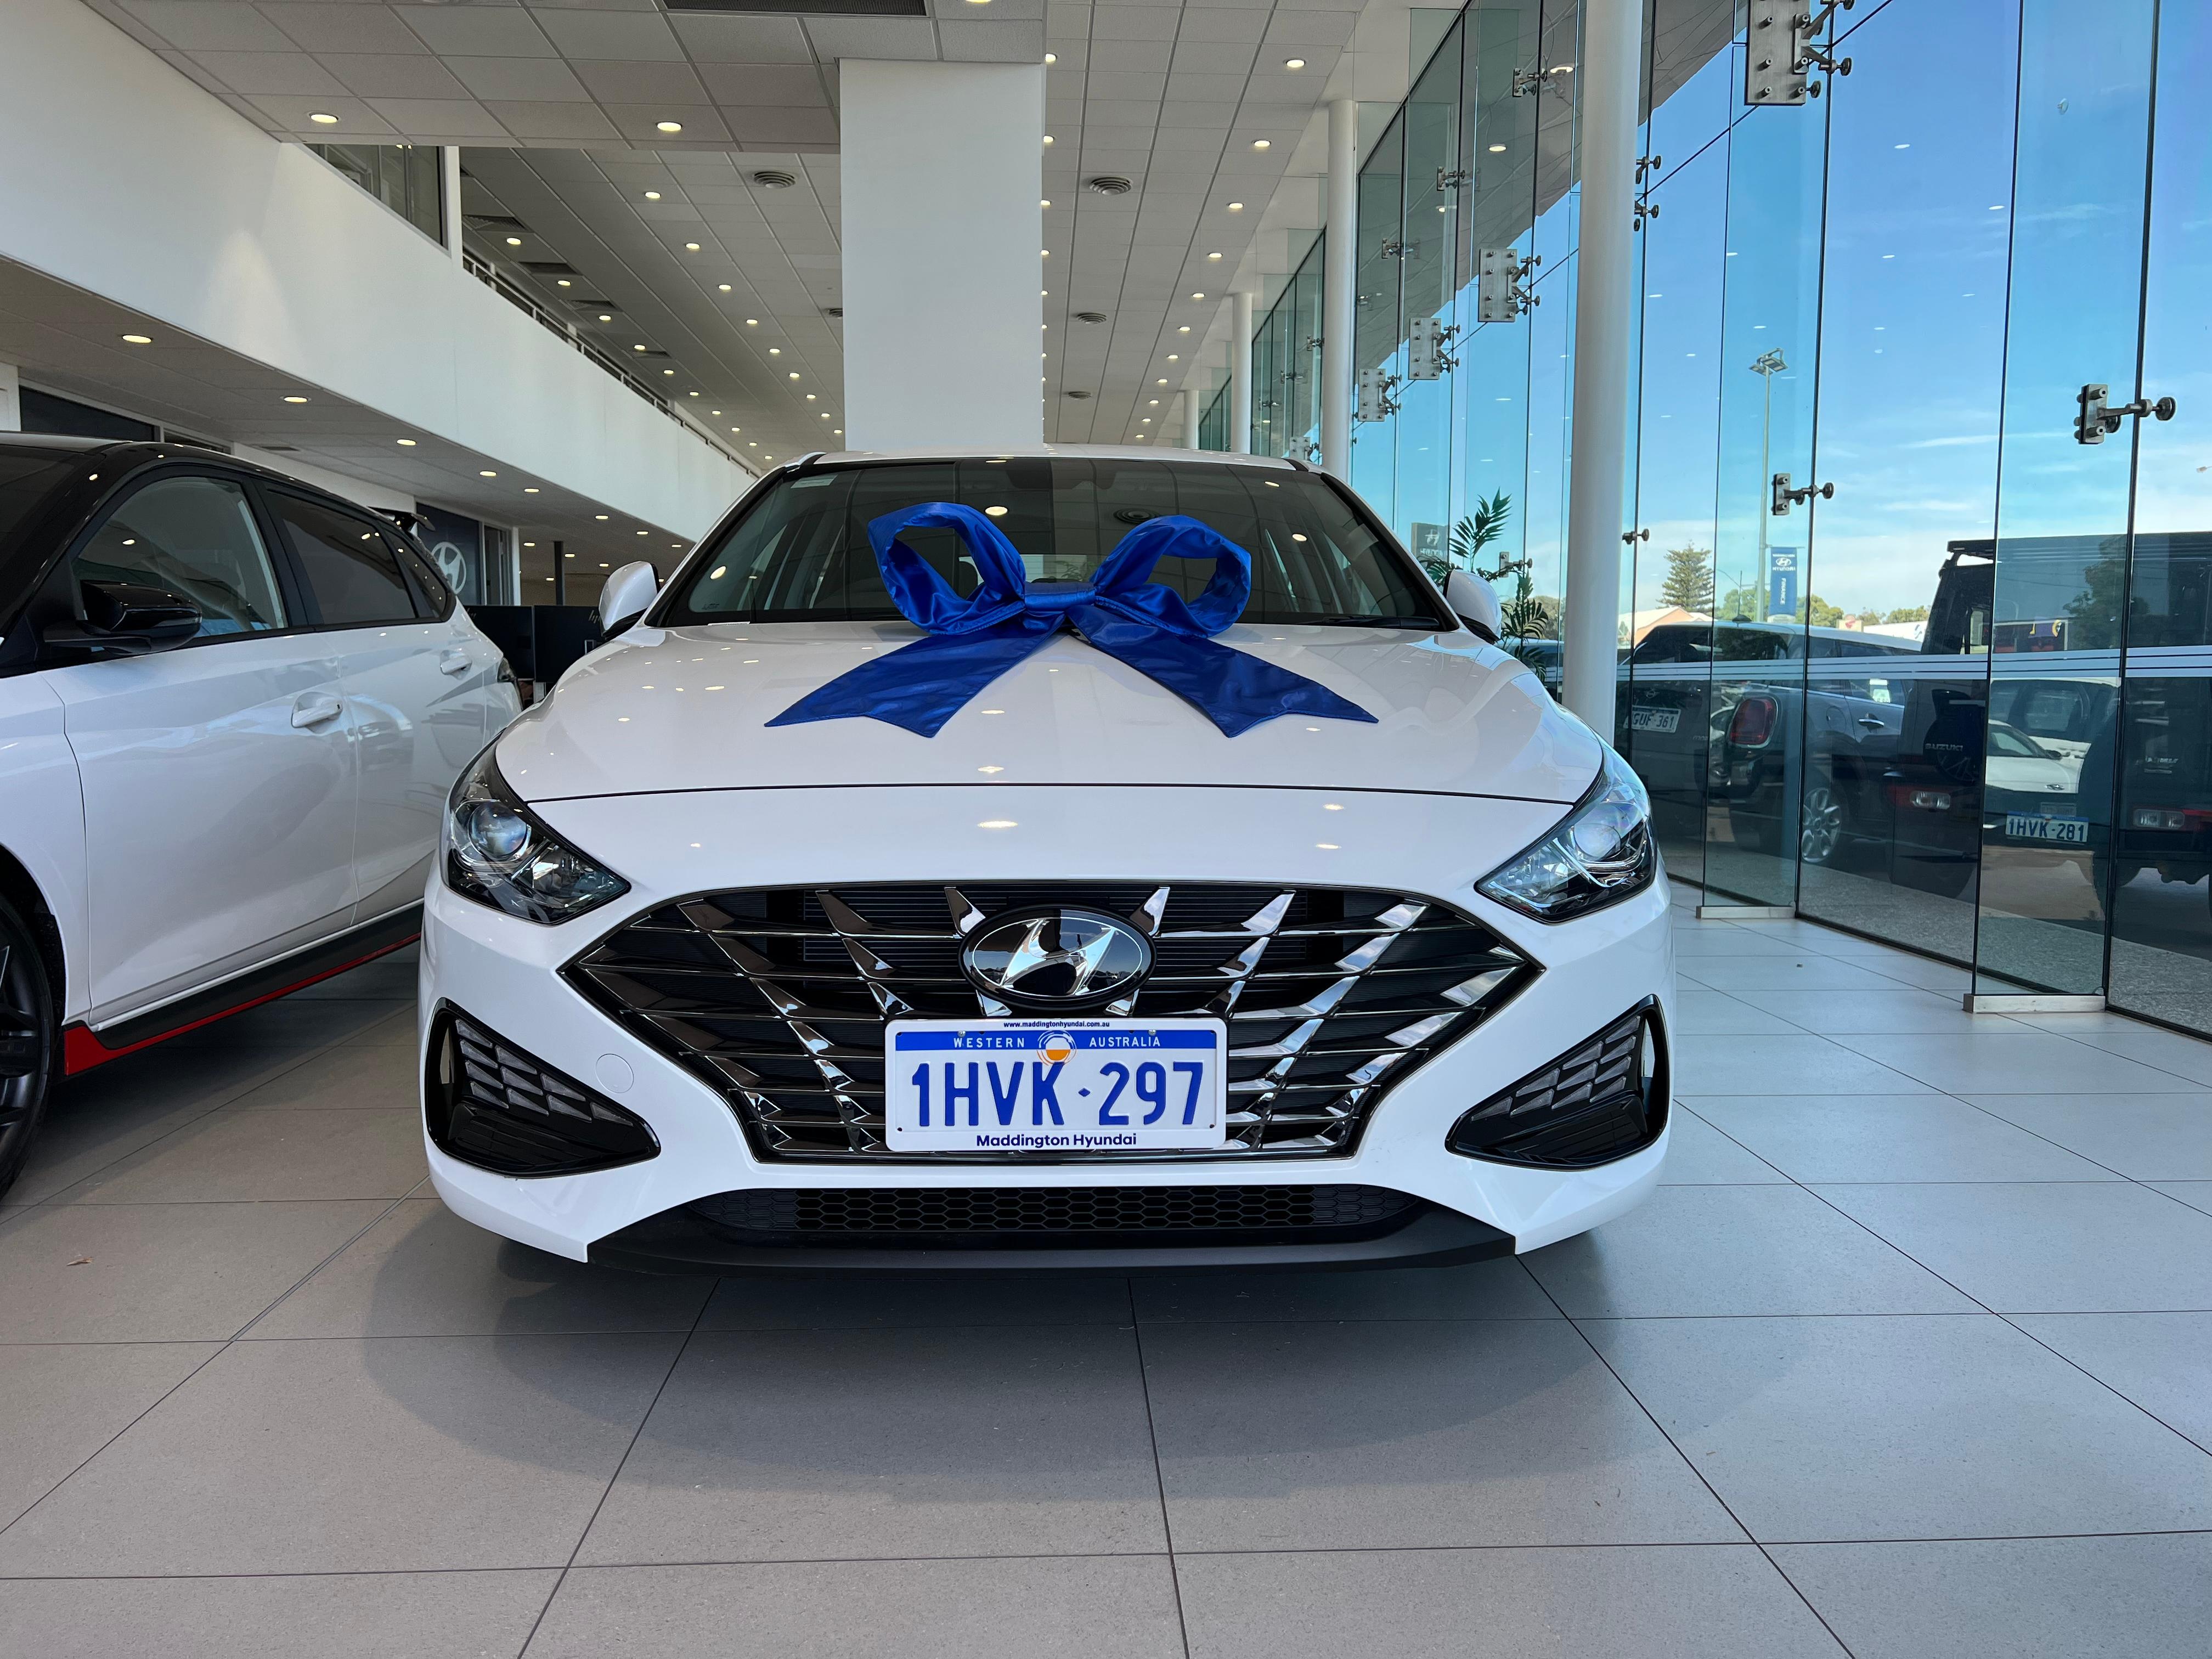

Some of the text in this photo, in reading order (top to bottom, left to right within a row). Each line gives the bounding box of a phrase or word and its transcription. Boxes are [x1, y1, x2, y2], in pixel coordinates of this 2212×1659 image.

[1656, 715, 1674, 729] 361
[953, 1036, 1160, 1048] WESTERN AUSTRALIA
[977, 1133, 1137, 1148] Maddington Hyundai
